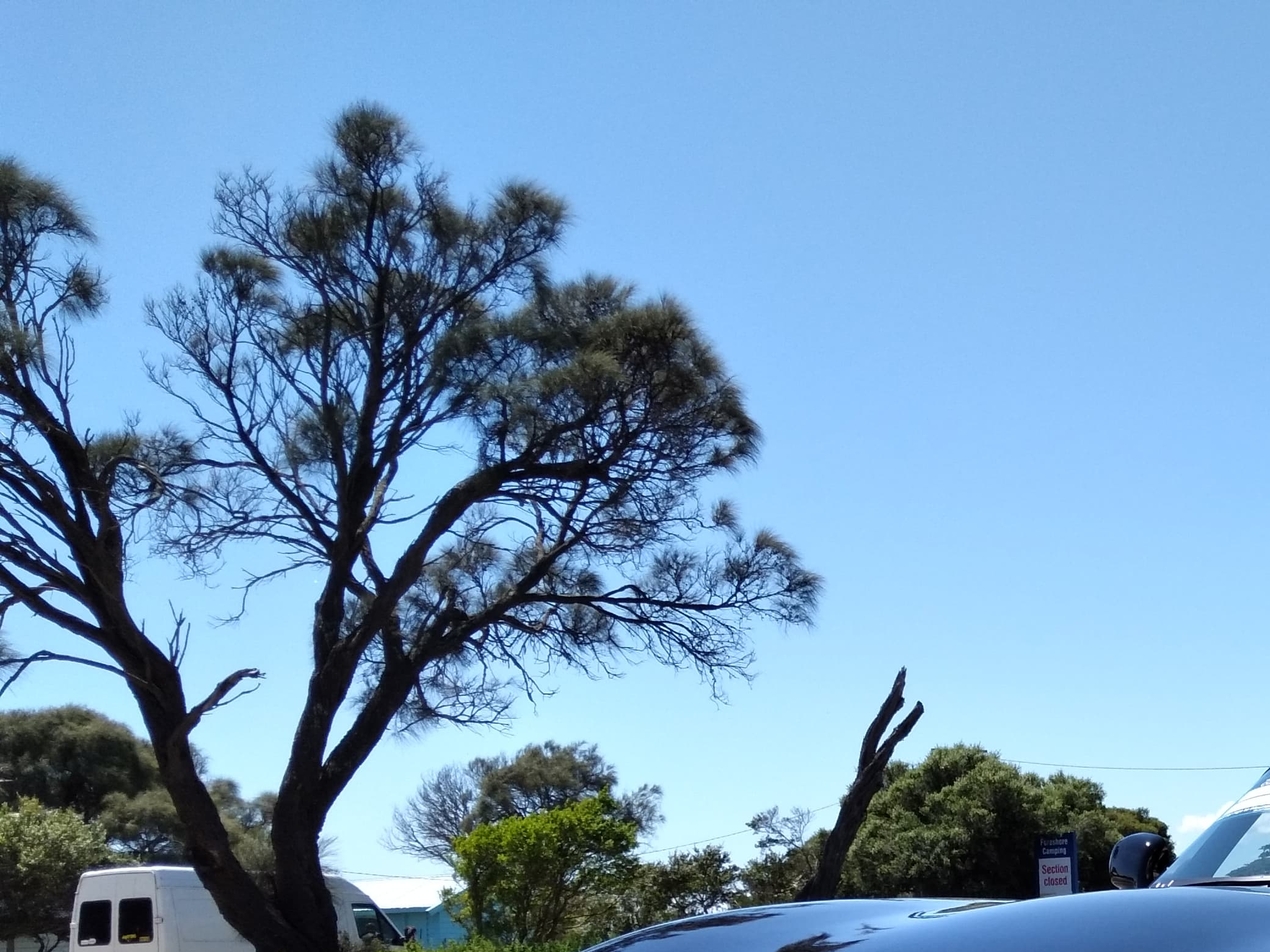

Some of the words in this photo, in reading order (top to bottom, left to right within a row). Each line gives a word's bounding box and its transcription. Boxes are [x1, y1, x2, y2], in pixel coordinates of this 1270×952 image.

[1040, 838, 1068, 847] Foreshore
[1042, 847, 1067, 856] Camping
[1041, 864, 1069, 875] Section
[1043, 876, 1068, 887] closed
